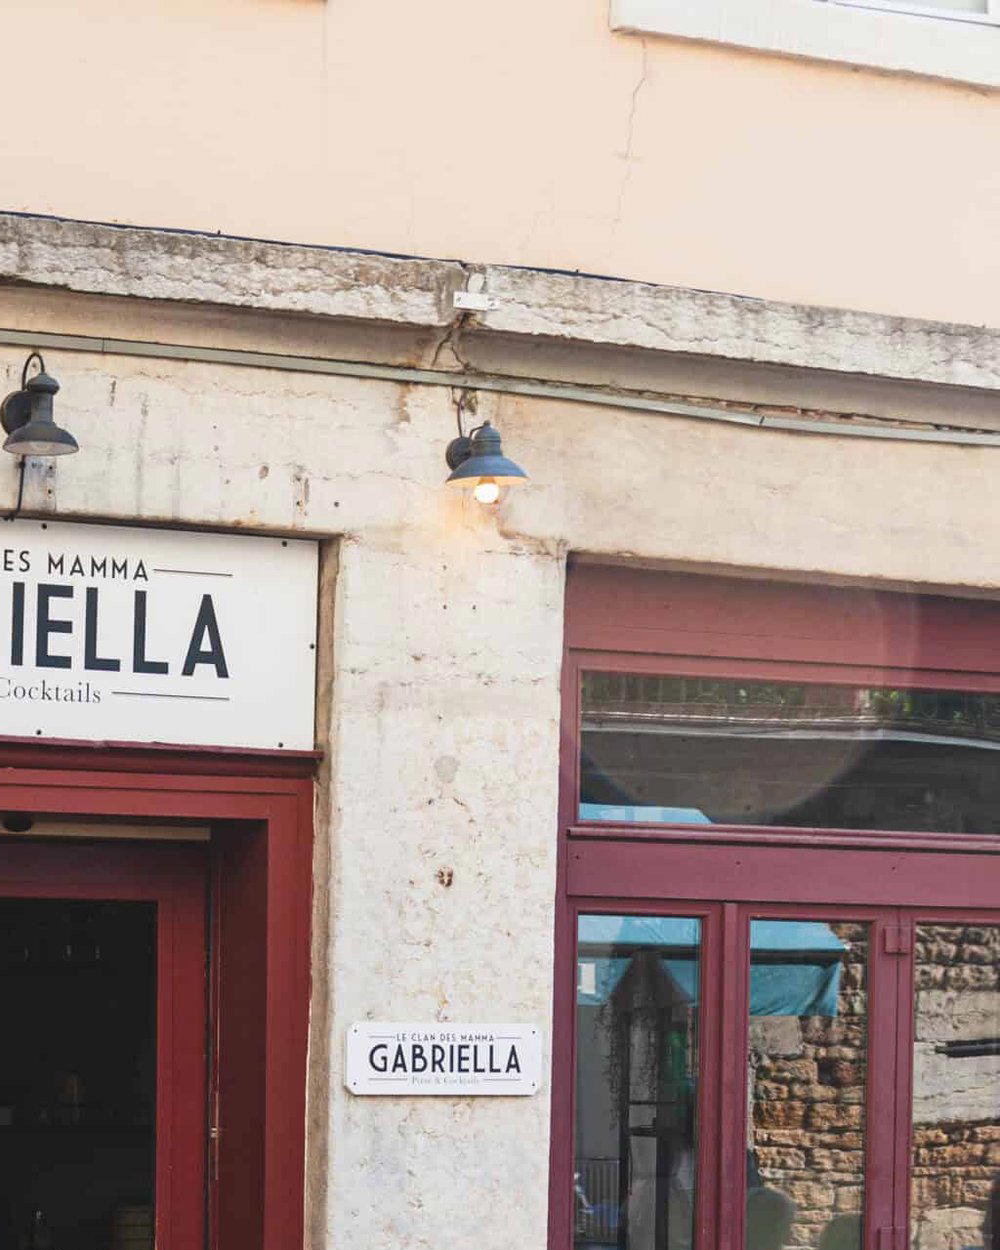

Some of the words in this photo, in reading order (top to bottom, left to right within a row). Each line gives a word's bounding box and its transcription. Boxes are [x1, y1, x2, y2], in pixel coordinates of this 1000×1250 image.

[47, 552, 150, 582] MAMMA
[395, 1033, 408, 1042] LE
[410, 1033, 437, 1042] CLAN
[439, 1034, 456, 1042] DES
[460, 1034, 495, 1042] MAMMA
[368, 1043, 522, 1074] GABRIELLA
